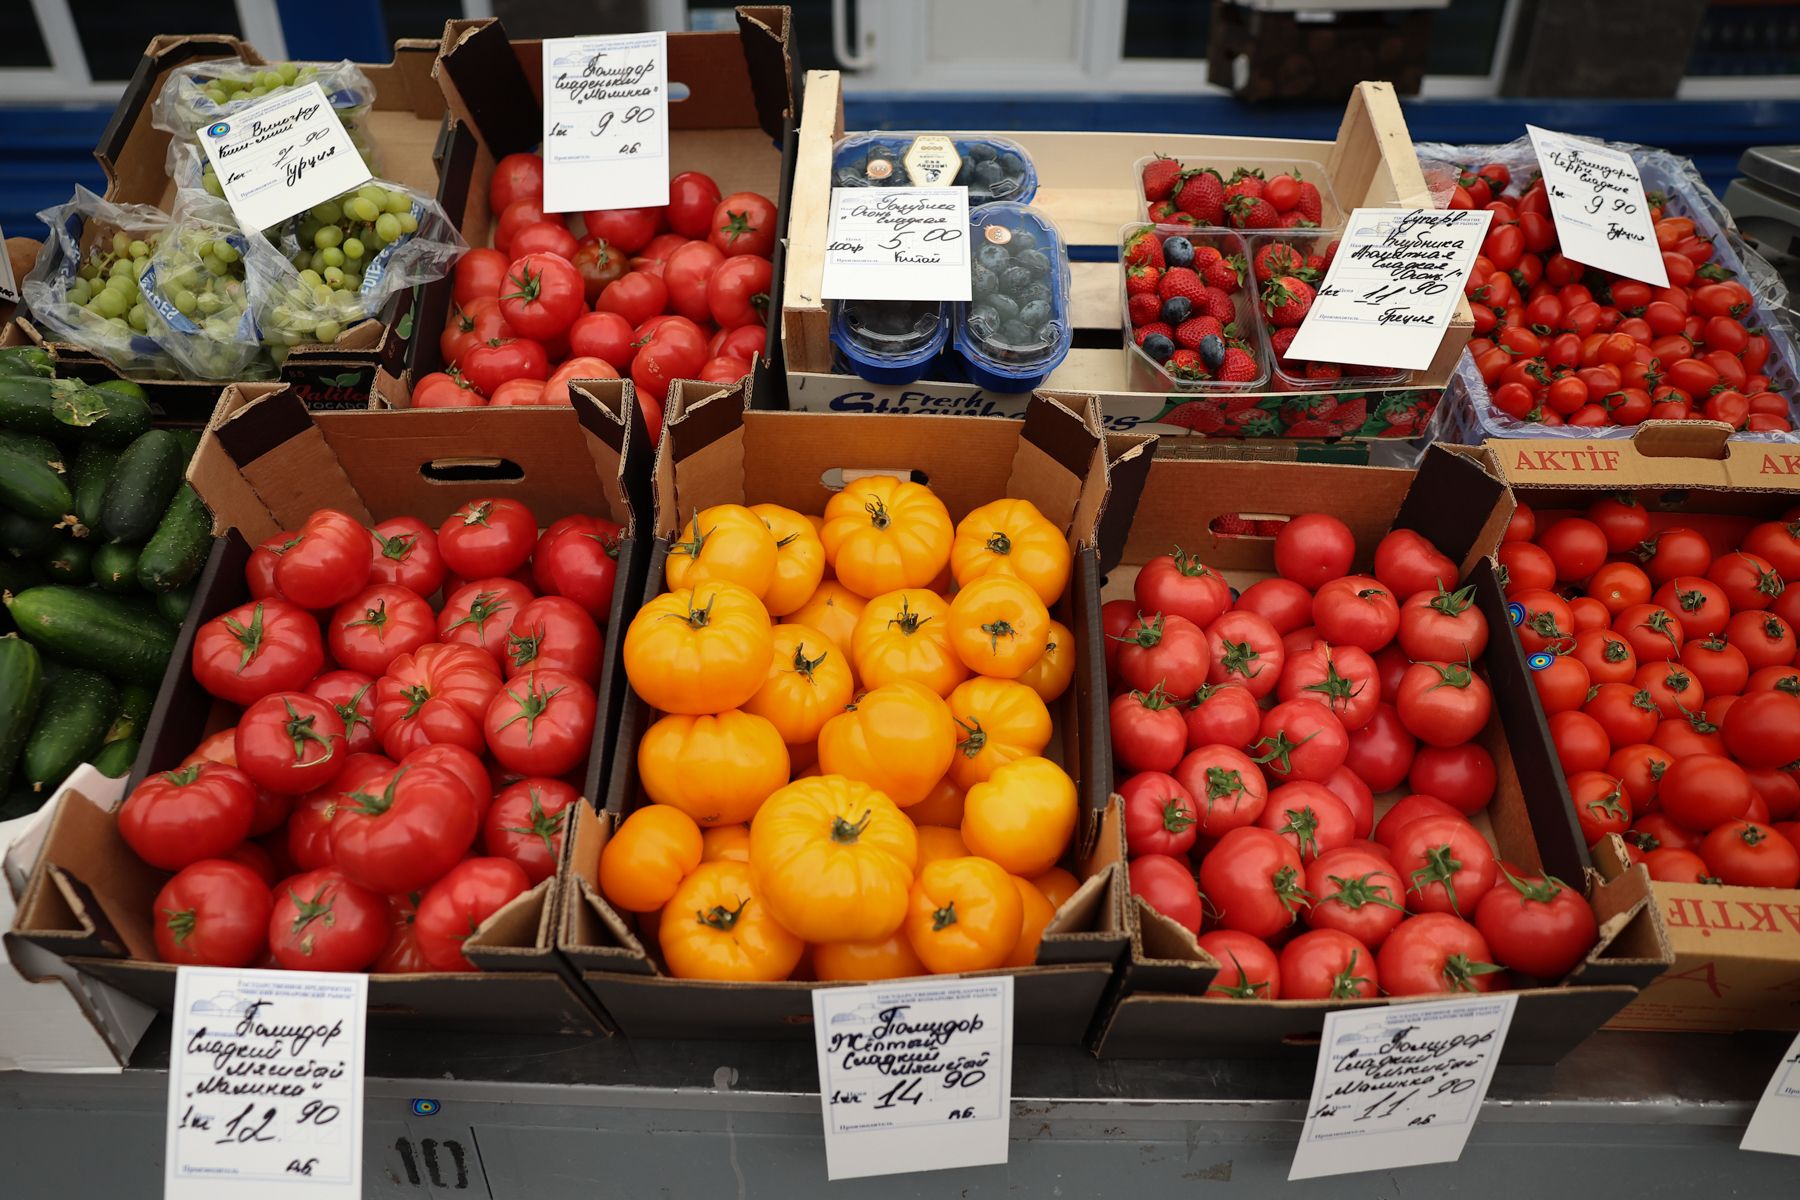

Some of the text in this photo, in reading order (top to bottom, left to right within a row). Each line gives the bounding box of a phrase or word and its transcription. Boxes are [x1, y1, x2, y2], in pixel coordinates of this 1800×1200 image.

[252, 104, 320, 137] Виноград
[621, 106, 655, 123] 90
[300, 127, 330, 147] 90
[1611, 198, 1637, 215] 90
[923, 228, 962, 242] 00
[894, 250, 941, 264] Китай
[1410, 281, 1448, 296] 90
[898, 390, 983, 408] Fresh
[187, 1026, 283, 1070] Сладкий
[943, 1070, 986, 1089] 90
[1428, 1078, 1476, 1099] 90
[297, 1099, 341, 1125] 90
